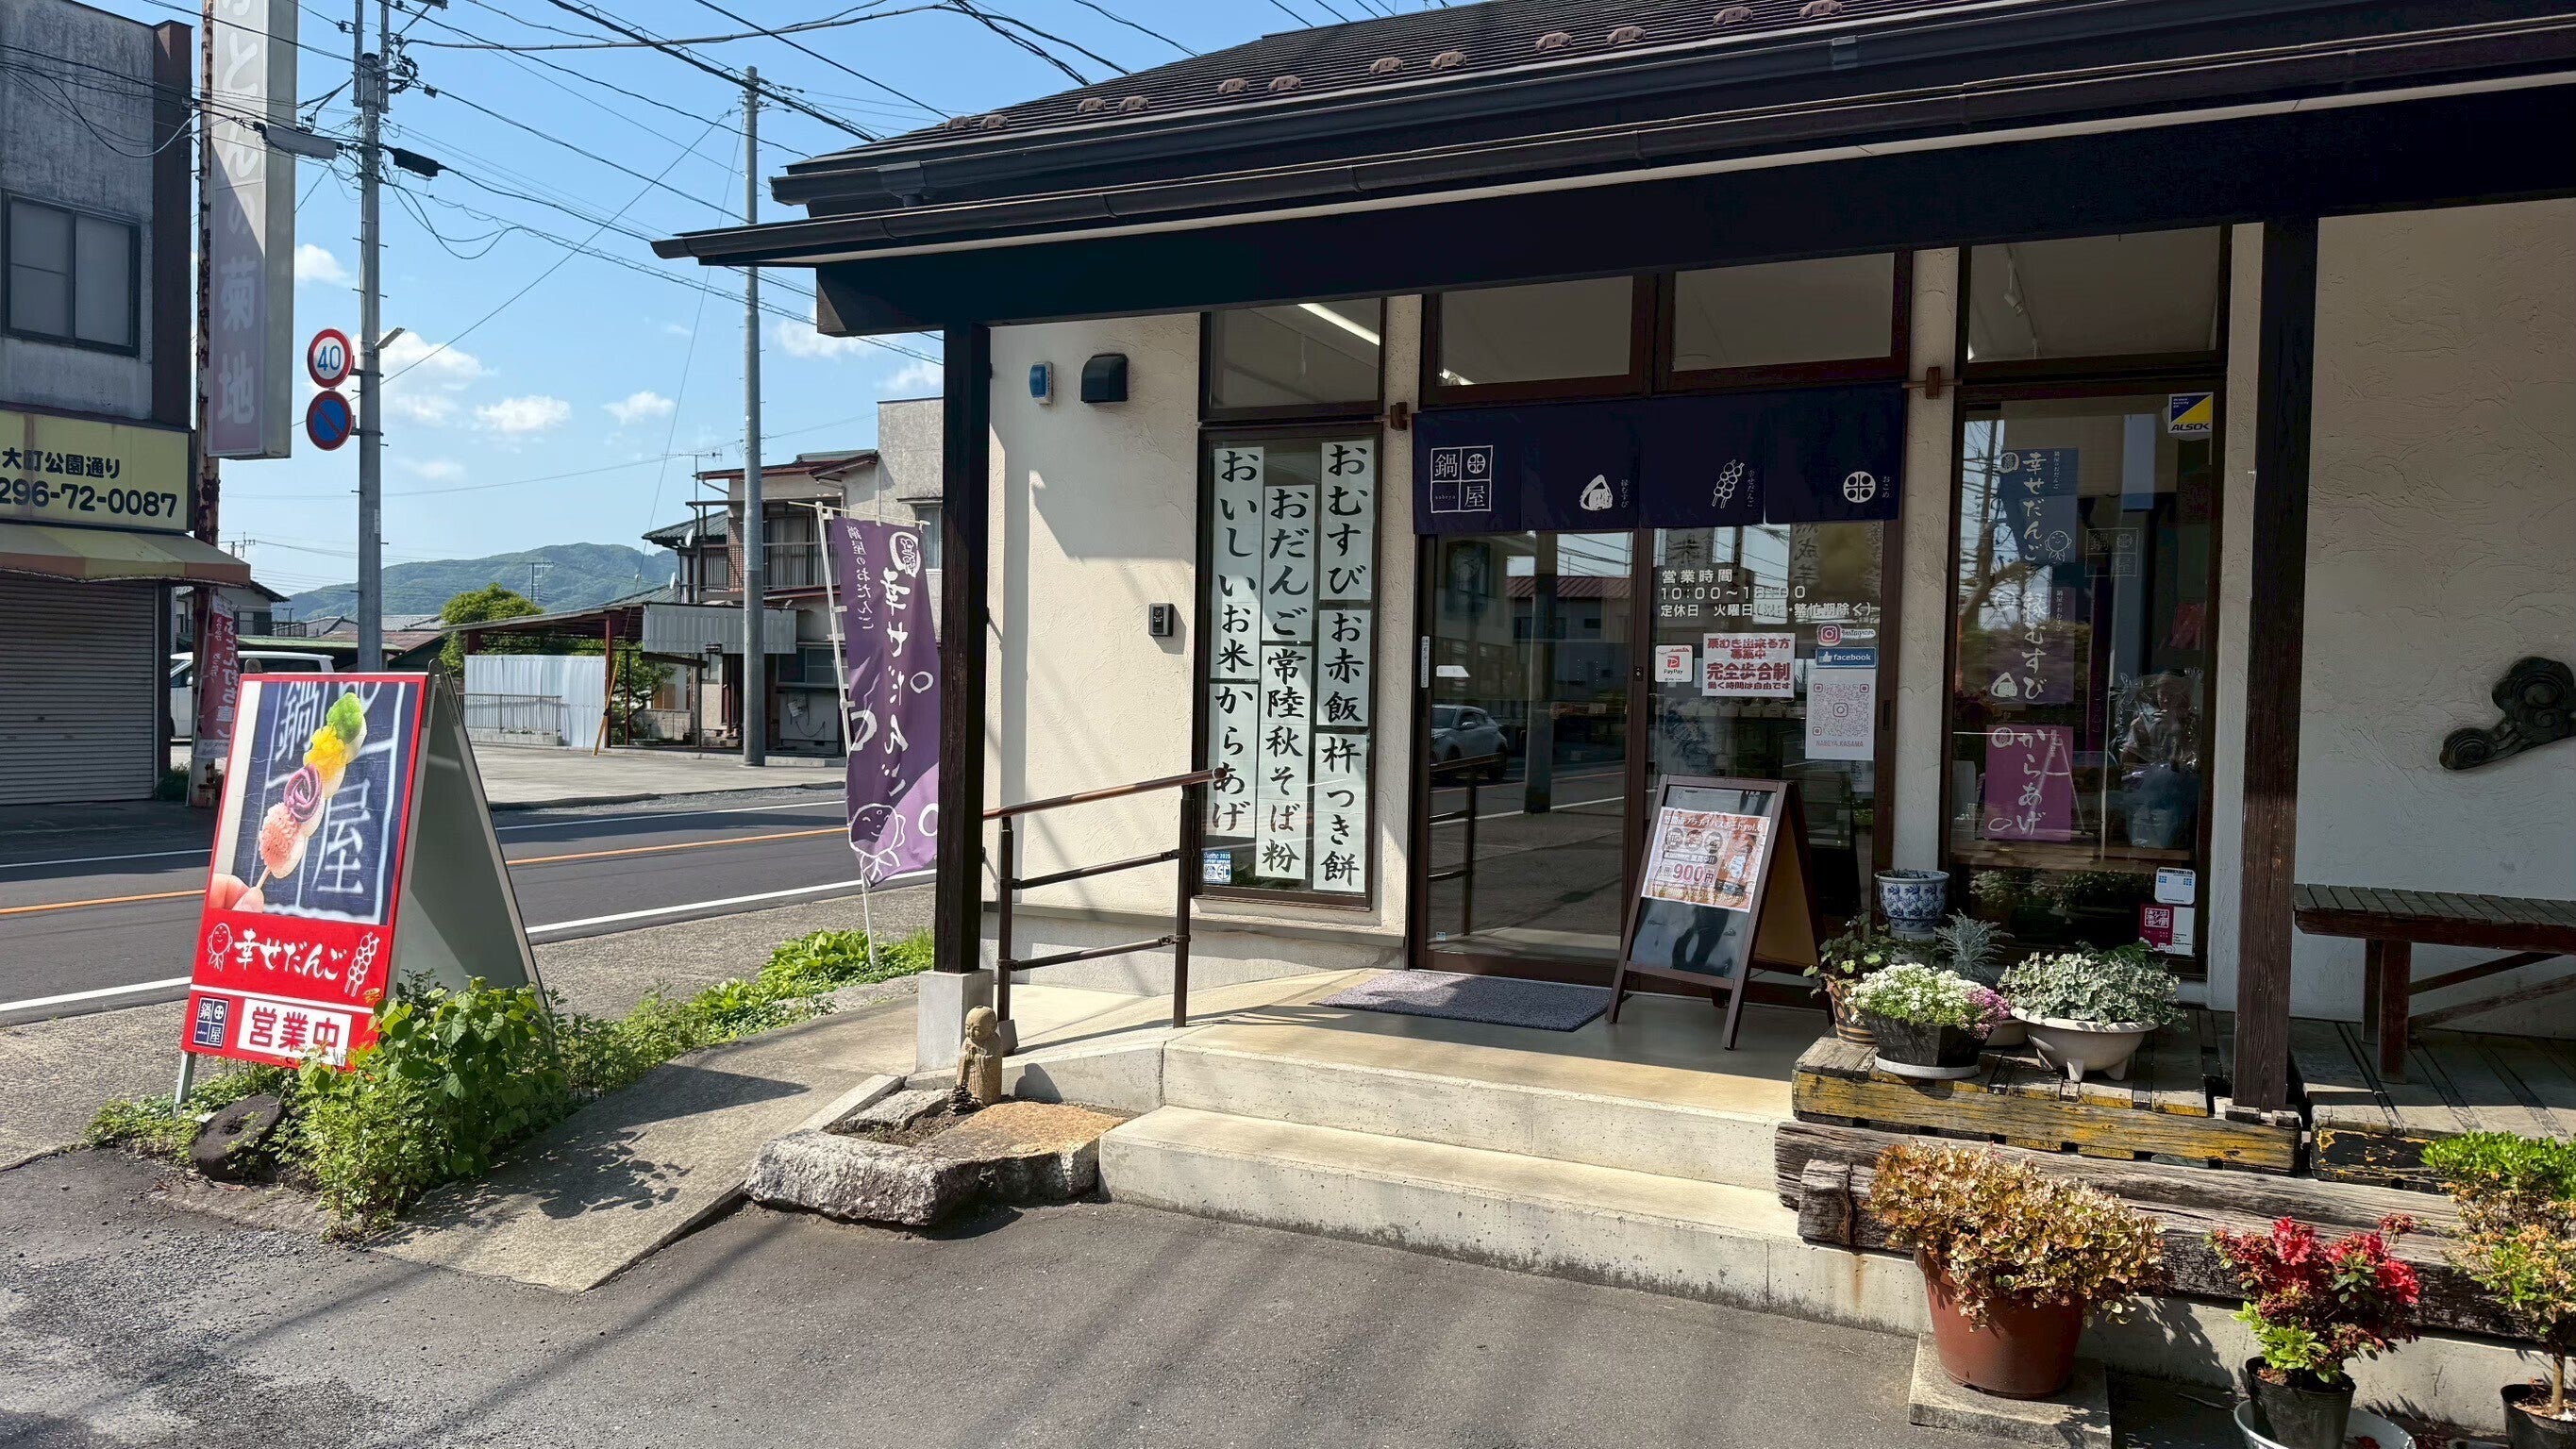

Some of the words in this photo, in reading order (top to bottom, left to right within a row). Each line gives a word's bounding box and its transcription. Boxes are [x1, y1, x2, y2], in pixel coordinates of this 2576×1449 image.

[218, 0, 259, 425] とんの菊地
[317, 345, 341, 371] 40
[2171, 423, 2210, 431] ALSOK
[2, 447, 121, 479] 大町公園通り
[1434, 454, 1458, 477] 鍋
[1327, 444, 1368, 595] おむすび
[1464, 485, 1485, 508] 屋
[2023, 451, 2047, 561] 幸せだんご
[1218, 451, 1259, 673] おいしいお米
[1268, 488, 1309, 636] おだんご
[1662, 569, 1732, 584] 営業時間
[1661, 604, 1698, 618] 定休日
[1324, 612, 1364, 723] お赤飯
[1663, 668, 1684, 676] PayPay
[1707, 662, 1791, 681] 完全歩合制
[1833, 653, 1871, 661] facebook
[1708, 681, 1791, 691] 働く時間は自由です
[1212, 687, 1253, 831] からあげ
[1262, 648, 1308, 874] 常陸秋そば粉
[2016, 728, 2047, 837] からあげ
[1320, 736, 1362, 887] 杵つき餅
[234, 928, 348, 981] 幸せだんご
[248, 1006, 341, 1055] 営業中
